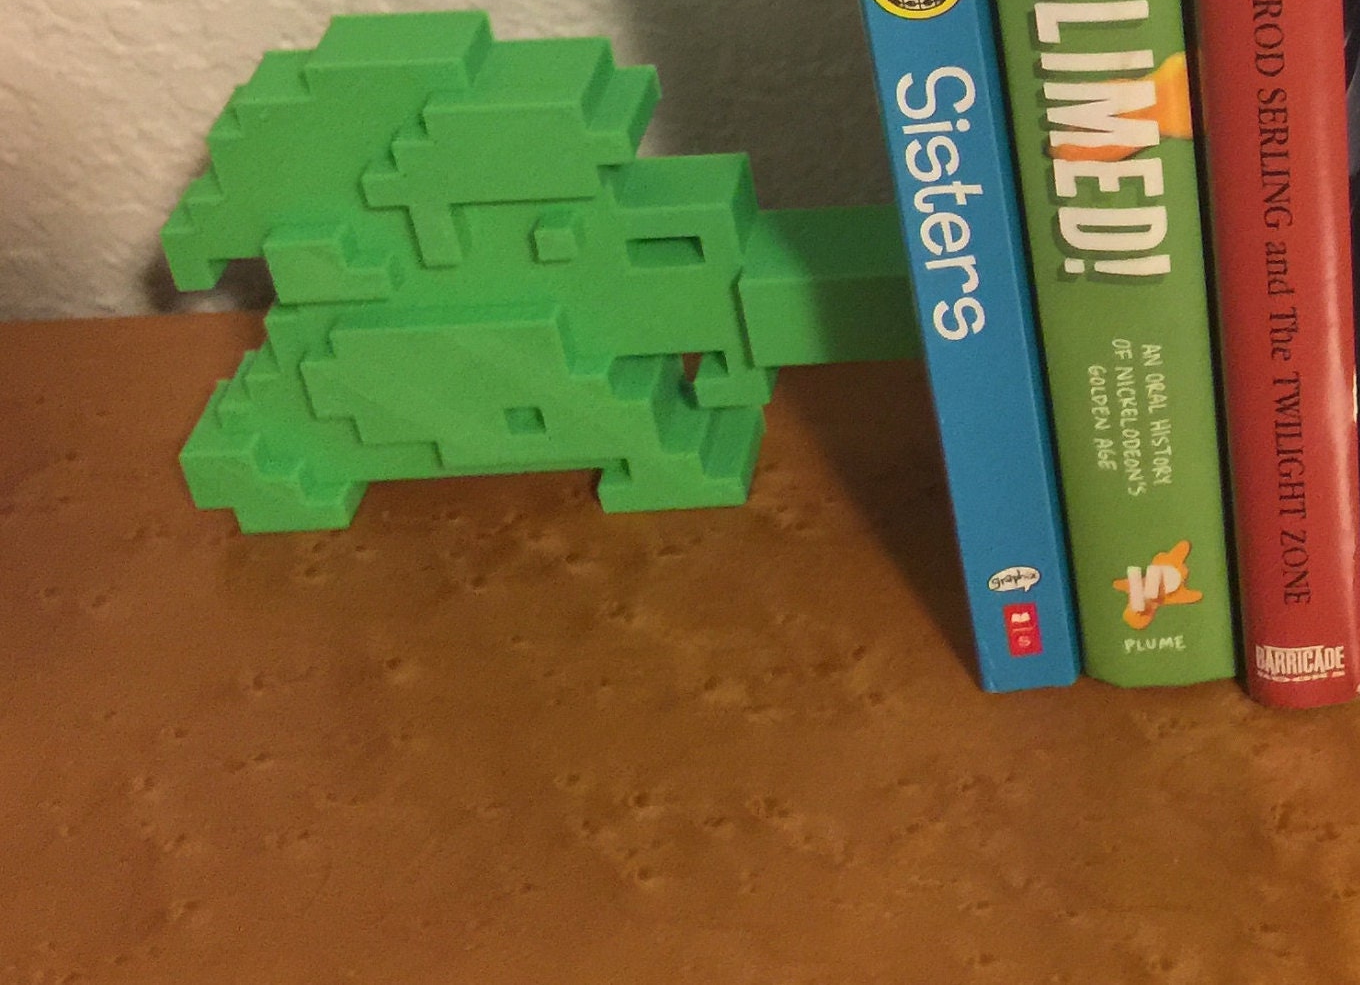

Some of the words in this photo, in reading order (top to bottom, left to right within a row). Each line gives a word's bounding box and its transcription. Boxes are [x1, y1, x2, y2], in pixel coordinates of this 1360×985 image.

[1256, 88, 1294, 230] SERLING
[896, 66, 986, 341] Sisters
[1264, 241, 1295, 297] and
[1111, 338, 1133, 360] OF
[1142, 344, 1163, 366] AN
[1269, 306, 1299, 362] The
[1088, 365, 1112, 431] GOLDEN
[1145, 373, 1168, 414] ORAL
[1094, 437, 1118, 471] AGE
[1115, 366, 1147, 497] NICKELODEON'S
[1150, 418, 1173, 486] HISTORY
[1272, 371, 1307, 519] TWILIGHT
[1280, 526, 1311, 605] ZONE
[1124, 635, 1186, 654] PLUME
[1255, 645, 1345, 675] BARRICADE
